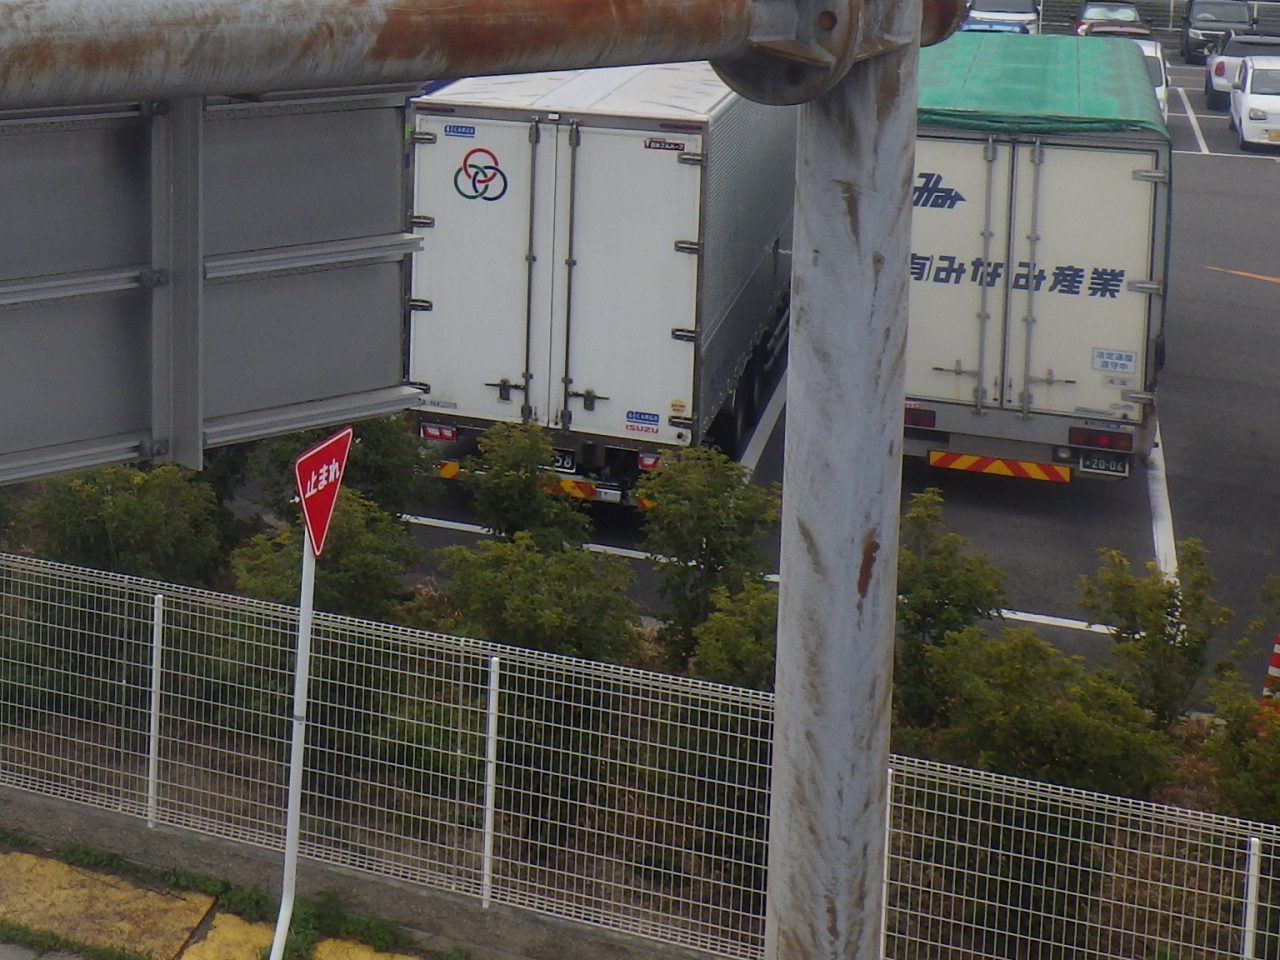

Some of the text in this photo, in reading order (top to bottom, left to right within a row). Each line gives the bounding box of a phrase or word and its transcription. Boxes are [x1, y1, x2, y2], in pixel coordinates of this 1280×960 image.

[625, 424, 659, 433] ISUZU
[305, 458, 340, 498] 止まれ
